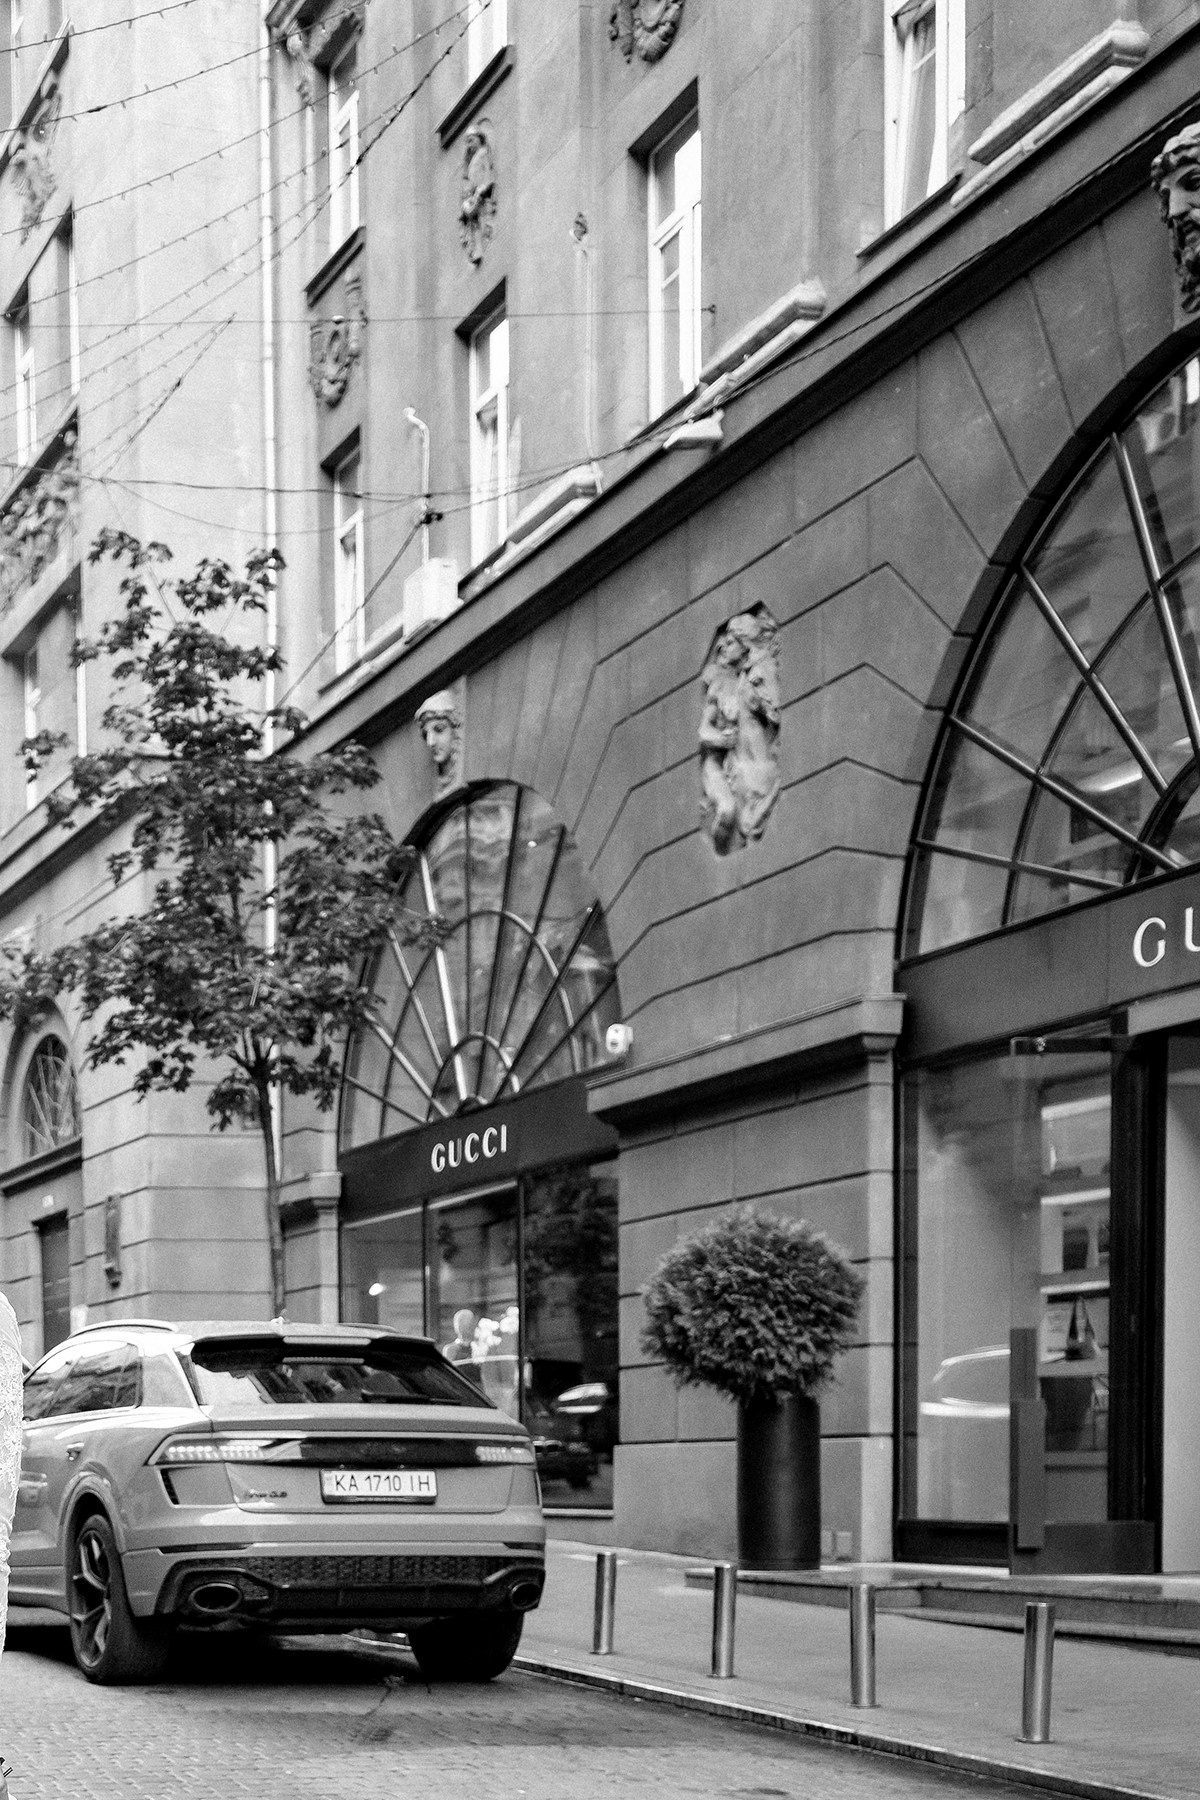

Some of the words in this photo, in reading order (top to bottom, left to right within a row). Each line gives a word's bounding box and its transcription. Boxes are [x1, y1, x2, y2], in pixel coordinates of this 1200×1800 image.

[431, 1123, 507, 1173] GUCCI
[334, 1474, 359, 1492] KA
[364, 1474, 402, 1492] 1710
[410, 1474, 431, 1492] IH
